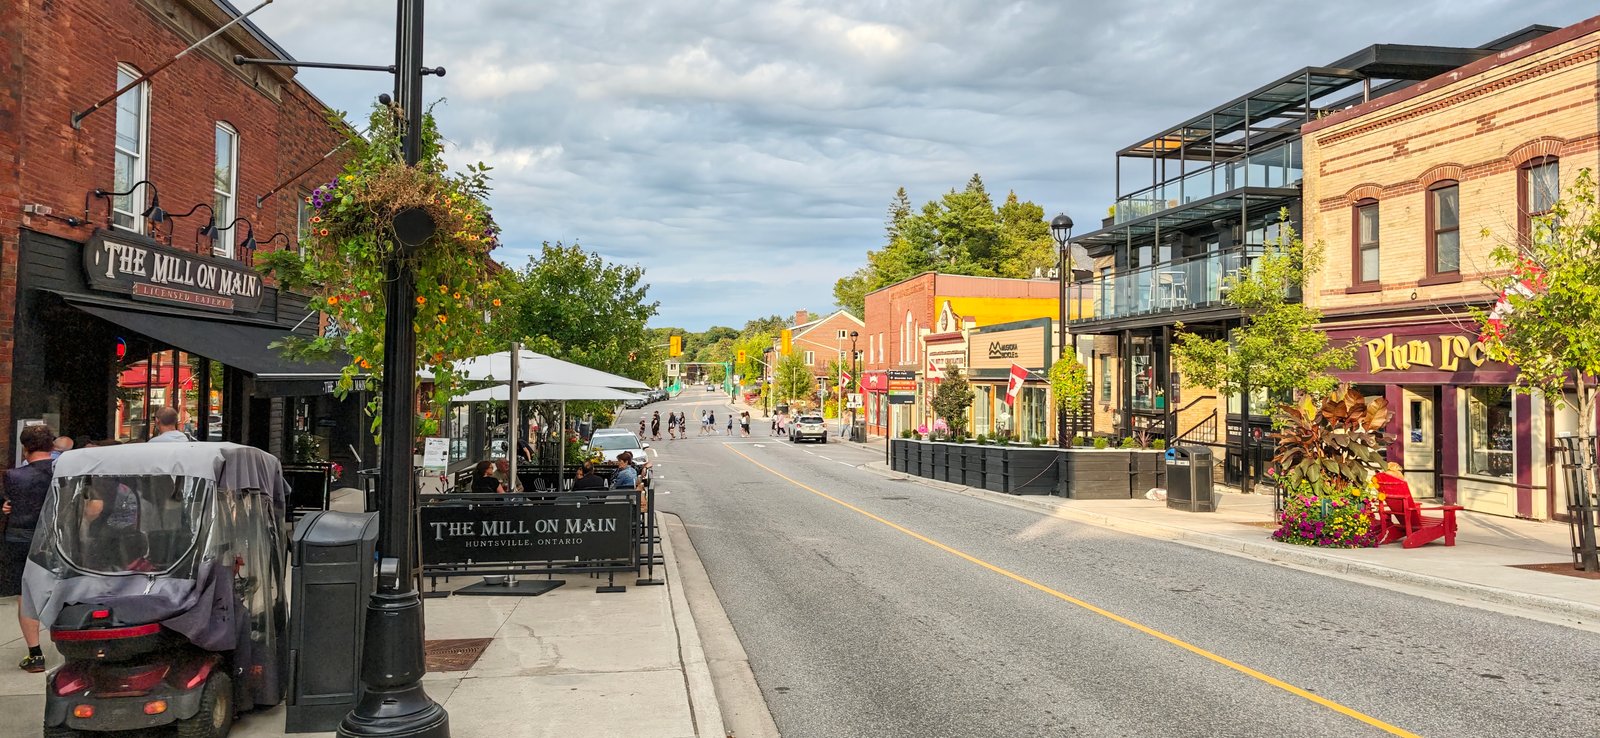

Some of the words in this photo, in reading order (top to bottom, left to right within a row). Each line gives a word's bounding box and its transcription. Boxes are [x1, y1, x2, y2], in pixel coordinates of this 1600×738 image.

[103, 240, 147, 278] THE
[150, 252, 195, 286] MILL
[196, 263, 218, 290] ON
[218, 268, 257, 297] MAIN
[143, 286, 190, 301] LICENSED
[195, 295, 226, 307] EATERY
[1364, 333, 1434, 374] Plum
[1438, 335, 1488, 372] Loc
[429, 521, 476, 541] THE
[480, 520, 530, 536] MILL
[534, 518, 559, 534] ON
[564, 518, 617, 535] MAIN
[465, 539, 533, 548] HUNTSVILLE,
[537, 537, 583, 546] ONTARIO
